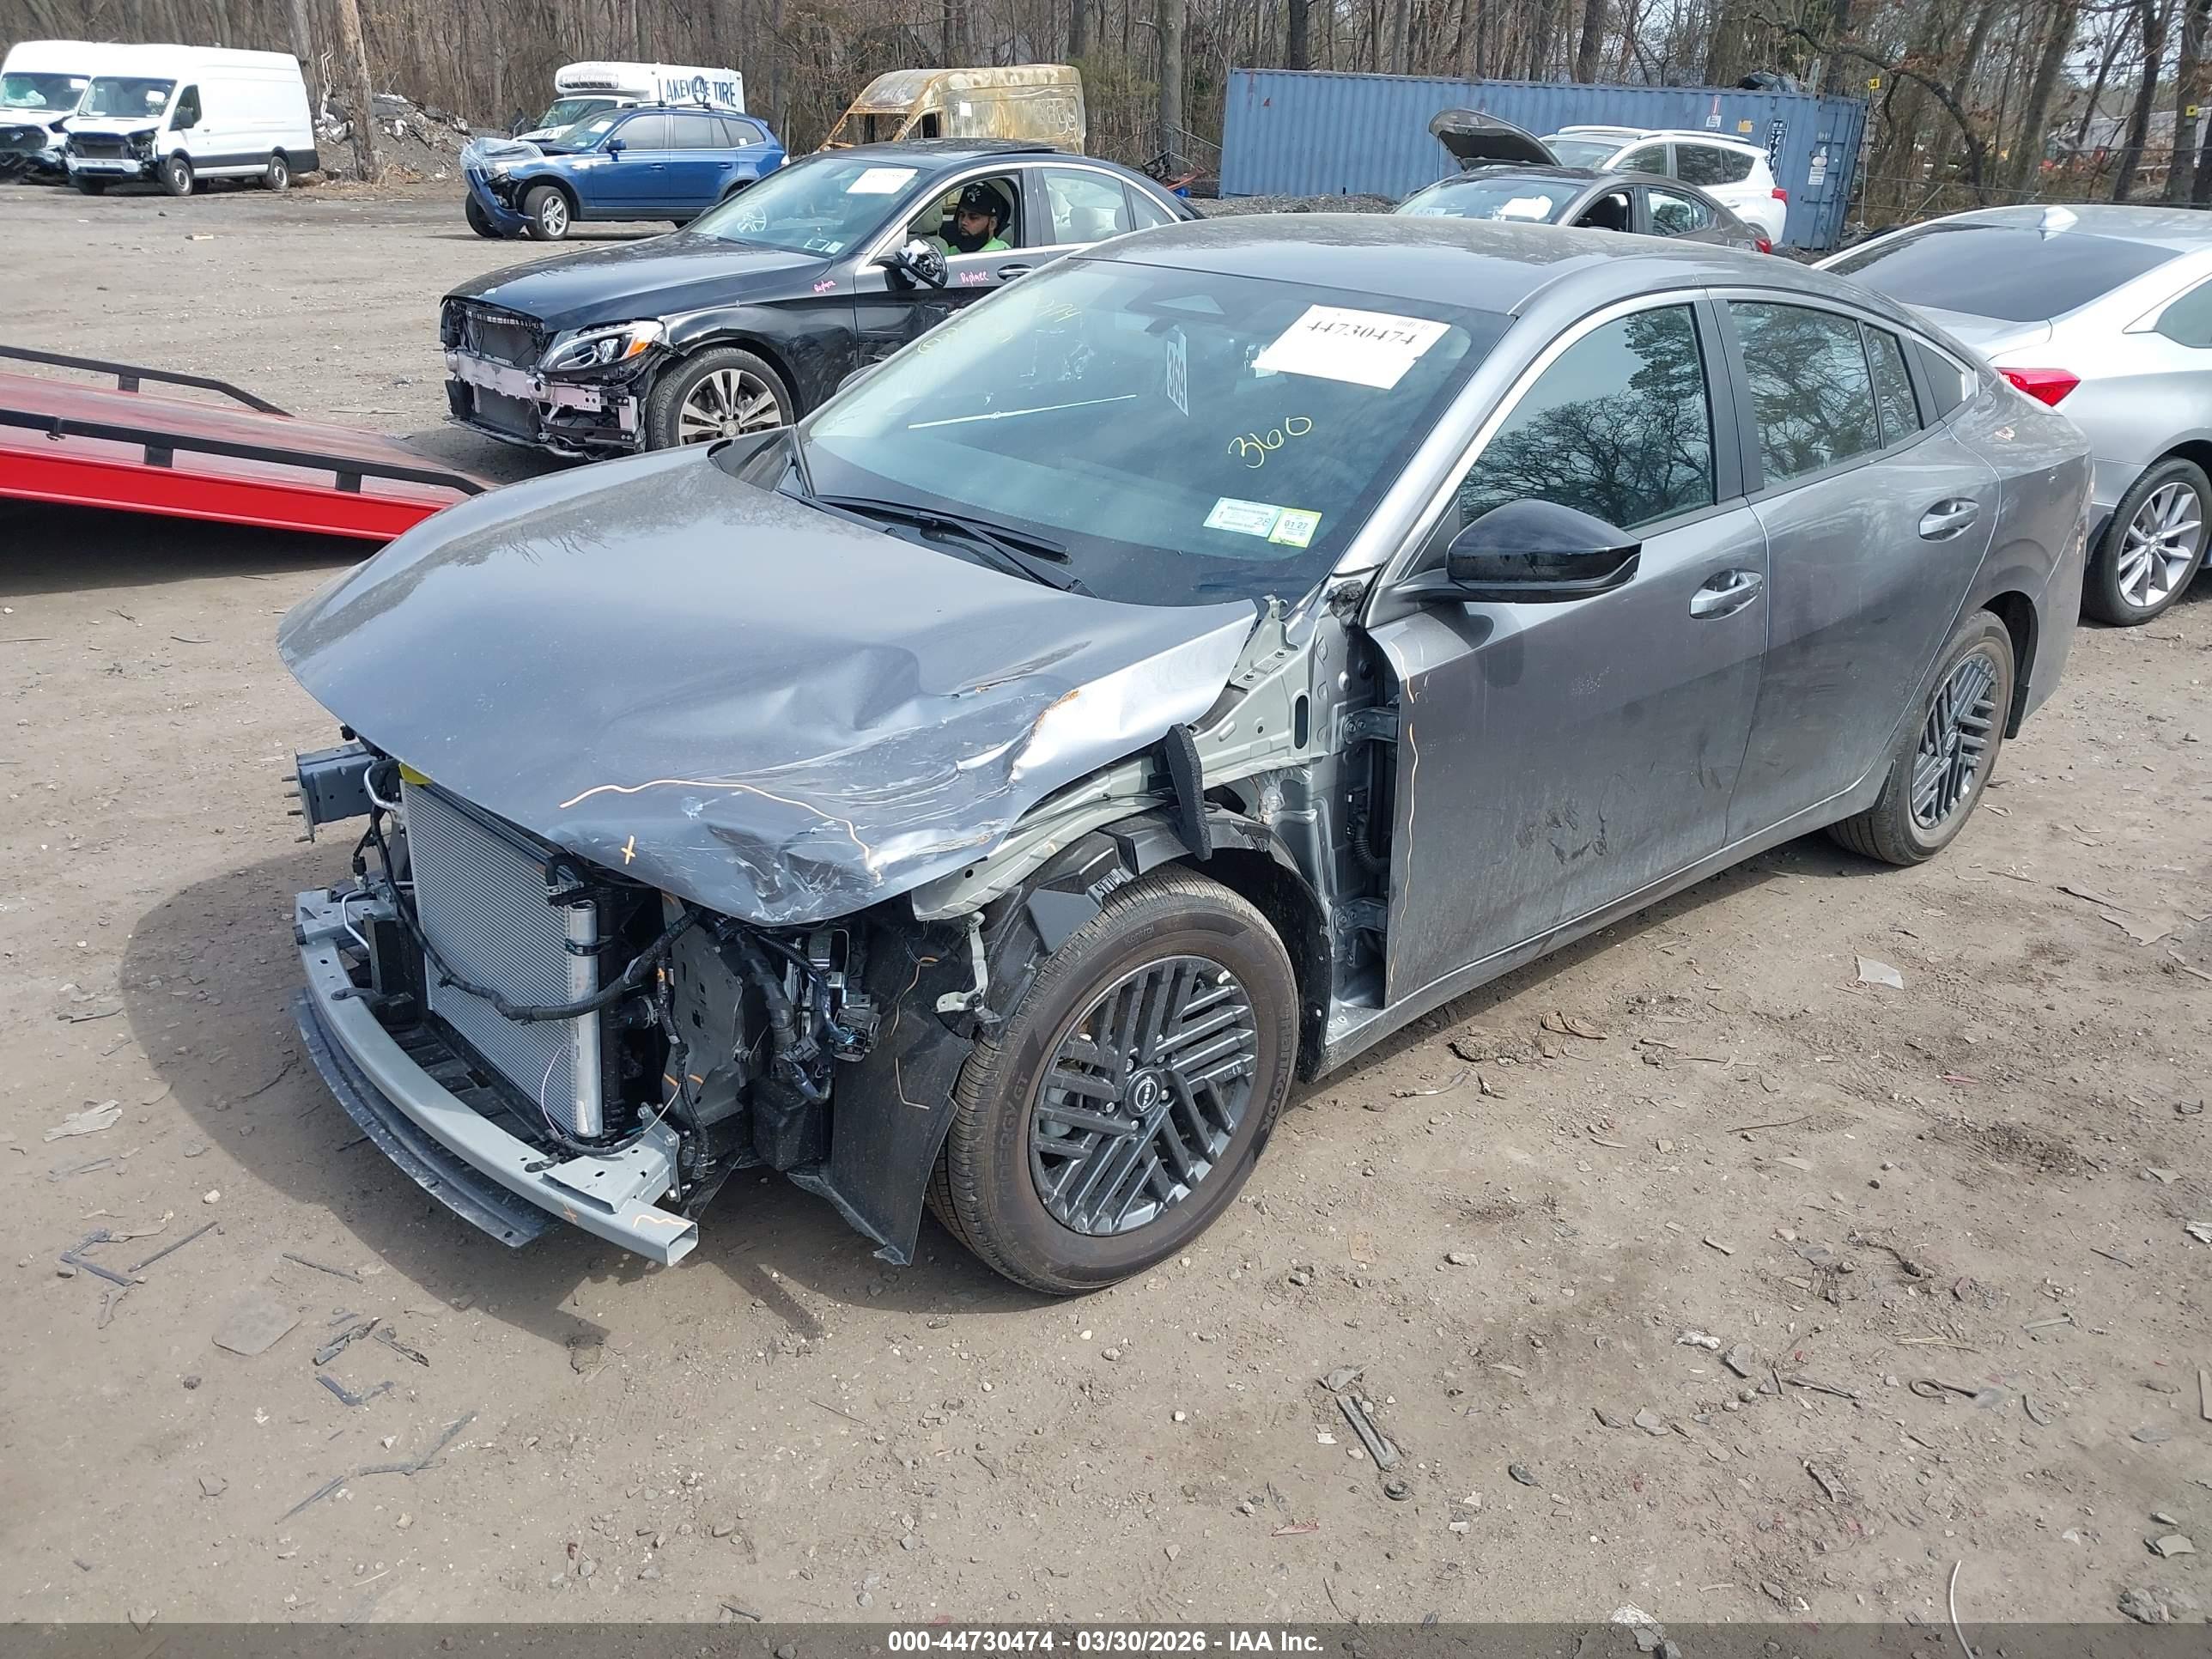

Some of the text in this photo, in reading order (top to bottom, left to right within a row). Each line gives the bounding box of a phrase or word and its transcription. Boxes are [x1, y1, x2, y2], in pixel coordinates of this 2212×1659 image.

[713, 82, 737, 107] TIRE
[1307, 320, 1417, 344] 44730474
[1169, 349, 1186, 410] 369
